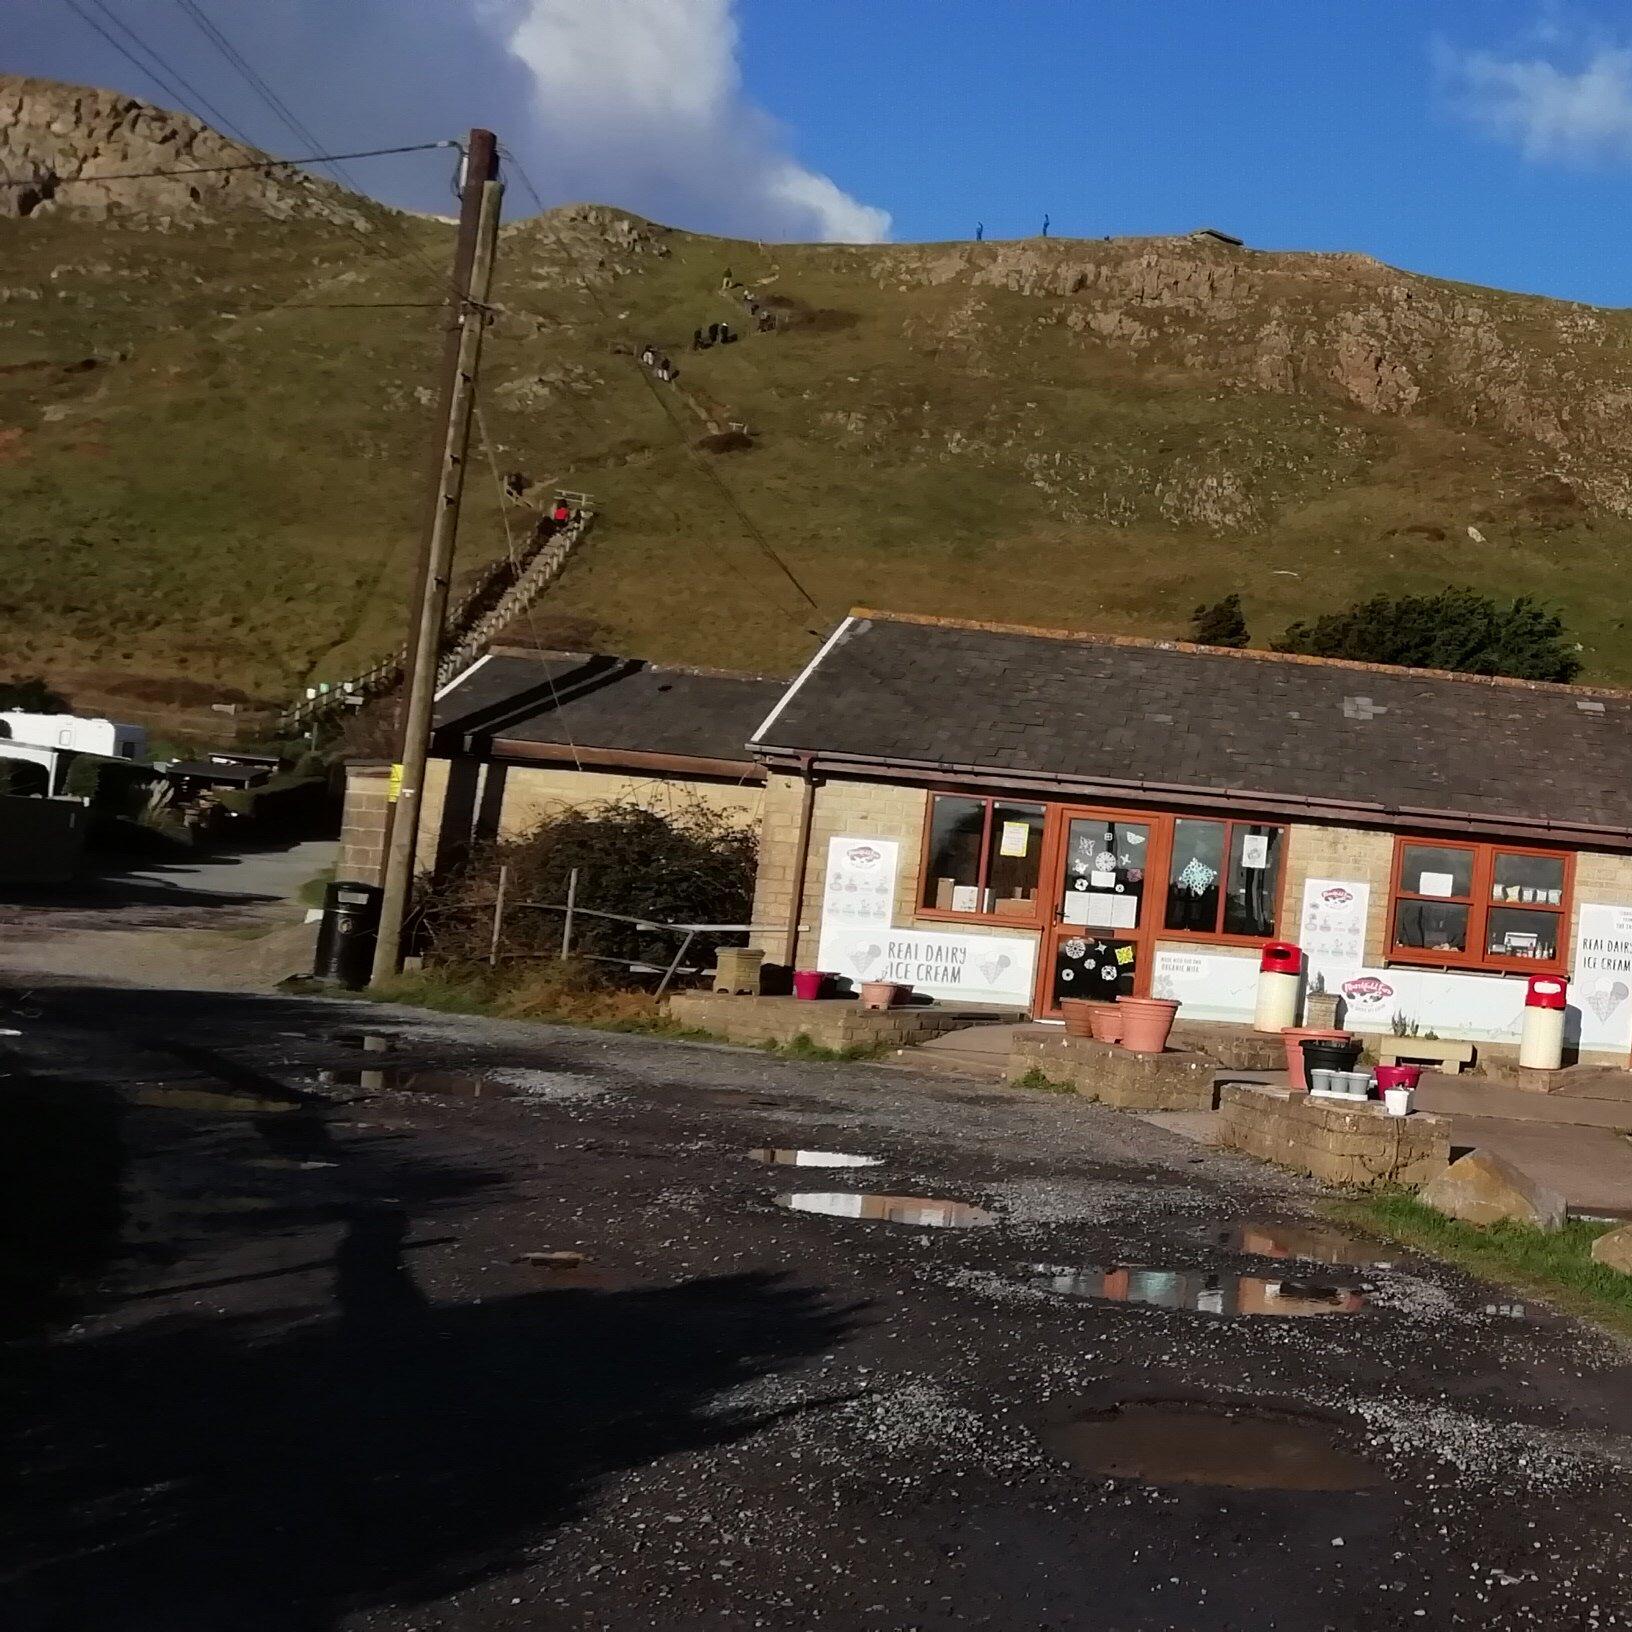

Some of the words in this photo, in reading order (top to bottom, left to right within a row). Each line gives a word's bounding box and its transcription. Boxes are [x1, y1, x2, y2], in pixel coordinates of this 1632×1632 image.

[888, 941, 919, 960] REAL
[926, 944, 967, 965] DAIRY
[1583, 938, 1603, 951] REAL
[890, 962, 911, 979] ICE
[917, 963, 961, 983] CREAM
[1583, 956, 1598, 969] ICE
[1601, 957, 1631, 971] CREAM
